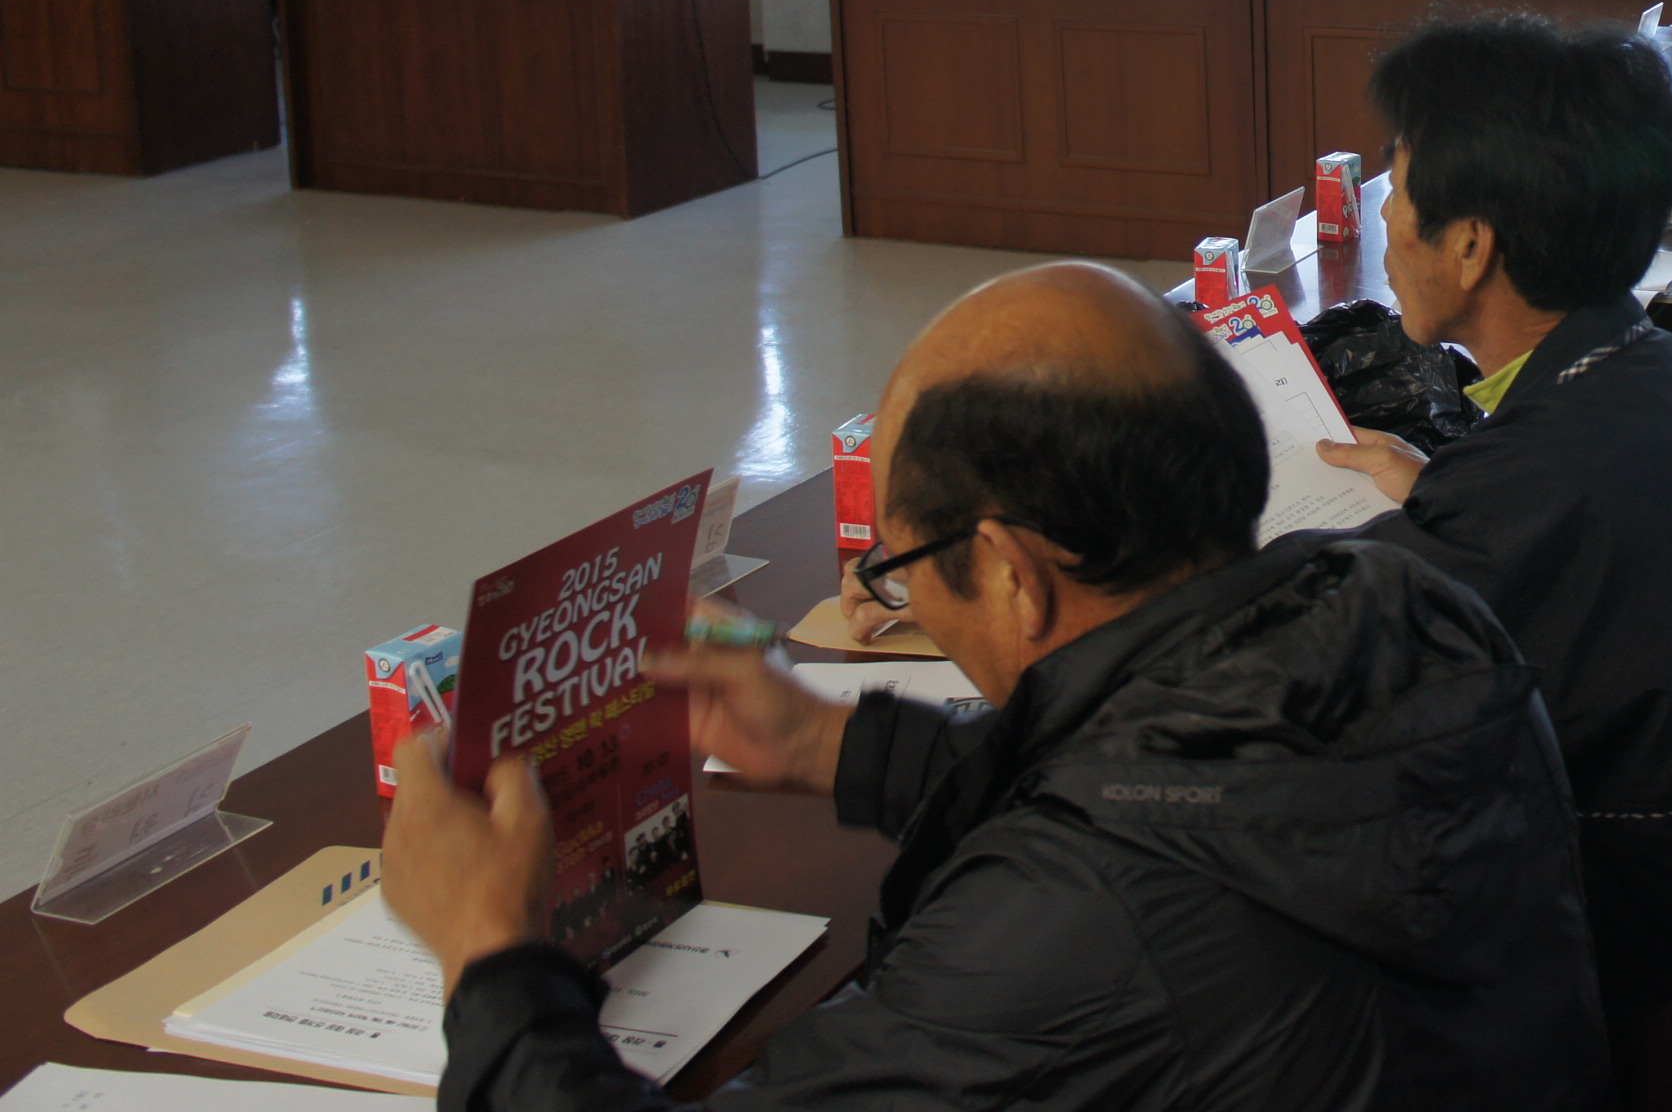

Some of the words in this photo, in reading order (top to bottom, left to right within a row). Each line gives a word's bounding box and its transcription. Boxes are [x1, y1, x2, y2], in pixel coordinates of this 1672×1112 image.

[499, 552, 663, 661] GYEONGSAN
[558, 546, 620, 602] 2015
[513, 593, 640, 704] ROCK
[1101, 784, 1162, 802] KOLON
[1164, 785, 1223, 804] SPORT
